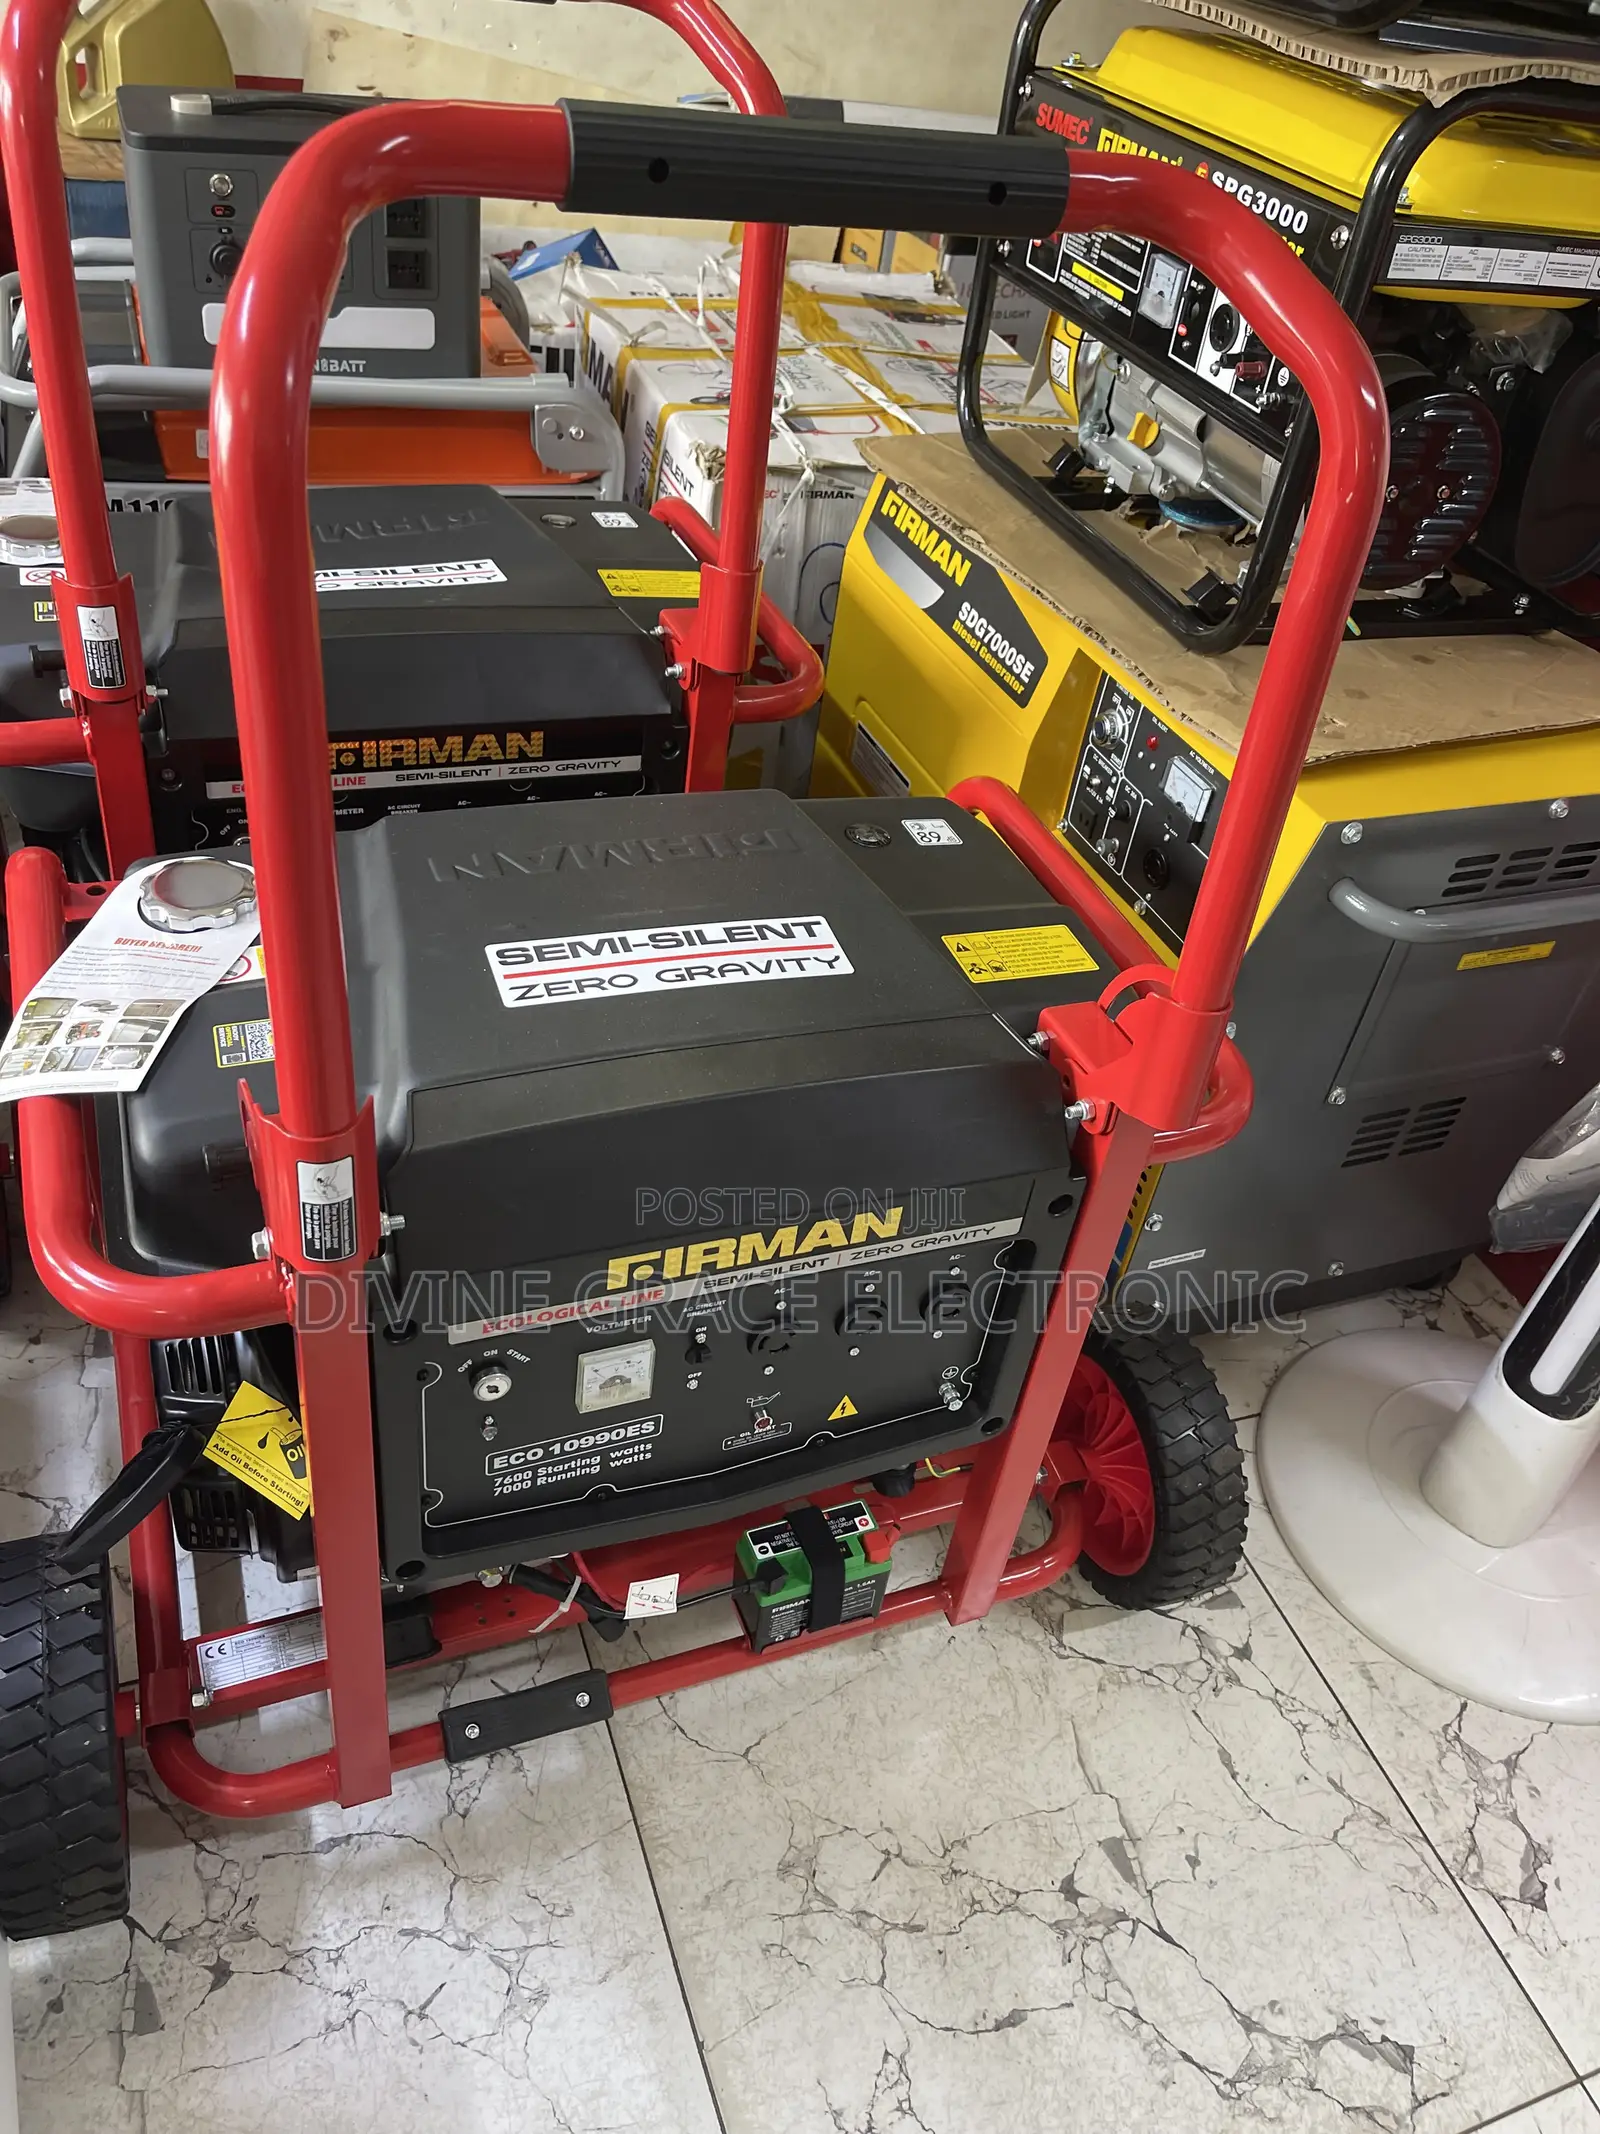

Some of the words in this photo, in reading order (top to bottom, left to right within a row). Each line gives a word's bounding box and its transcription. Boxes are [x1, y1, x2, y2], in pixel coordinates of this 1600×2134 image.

[1036, 102, 1090, 145] SUMEC
[1211, 170, 1309, 234] SPG3000
[1399, 235, 1443, 244] SPG3000
[602, 517, 622, 526] 89
[880, 490, 972, 587] FIRMAN
[354, 574, 499, 588] GRAVITY
[952, 619, 980, 652] Diesel
[979, 645, 1025, 695] Generator
[958, 601, 1035, 684] SDG7000SE
[328, 731, 544, 769] FIRMAN
[334, 776, 366, 787] LINE
[395, 769, 492, 782] SEMI-SILENT
[508, 765, 550, 775] ZERO
[555, 760, 621, 771] GRAVITY
[334, 807, 365, 815] METER
[916, 831, 942, 843] 89
[495, 921, 822, 966] SEMI-SILENT
[509, 974, 638, 1002] ZERO
[655, 955, 841, 984] GRAVITY
[607, 1206, 904, 1292] FIRMAN
[482, 1300, 614, 1335] ECOLOGICAL
[621, 1289, 664, 1310] LINE
[704, 1257, 830, 1290] SEMI-SILENT
[849, 1244, 904, 1263] ZERO
[910, 1225, 998, 1250] GRAVITY
[586, 1315, 652, 1333] VOLTMETER
[457, 1358, 474, 1373] OFF
[483, 1348, 499, 1358] ON
[506, 1348, 531, 1364] START
[687, 1371, 702, 1379] OFF
[493, 1448, 545, 1470] ECO
[549, 1421, 656, 1455] 10990ES
[493, 1470, 533, 1487] 7600
[537, 1453, 601, 1477] Starting
[609, 1442, 653, 1459] watts
[212, 1443, 229, 1456] Add
[231, 1453, 242, 1465] Oil
[242, 1461, 268, 1483] Before
[269, 1480, 305, 1507] Starting!
[493, 1480, 532, 1497] 7000
[536, 1464, 601, 1487] Running
[609, 1451, 653, 1468] watts
